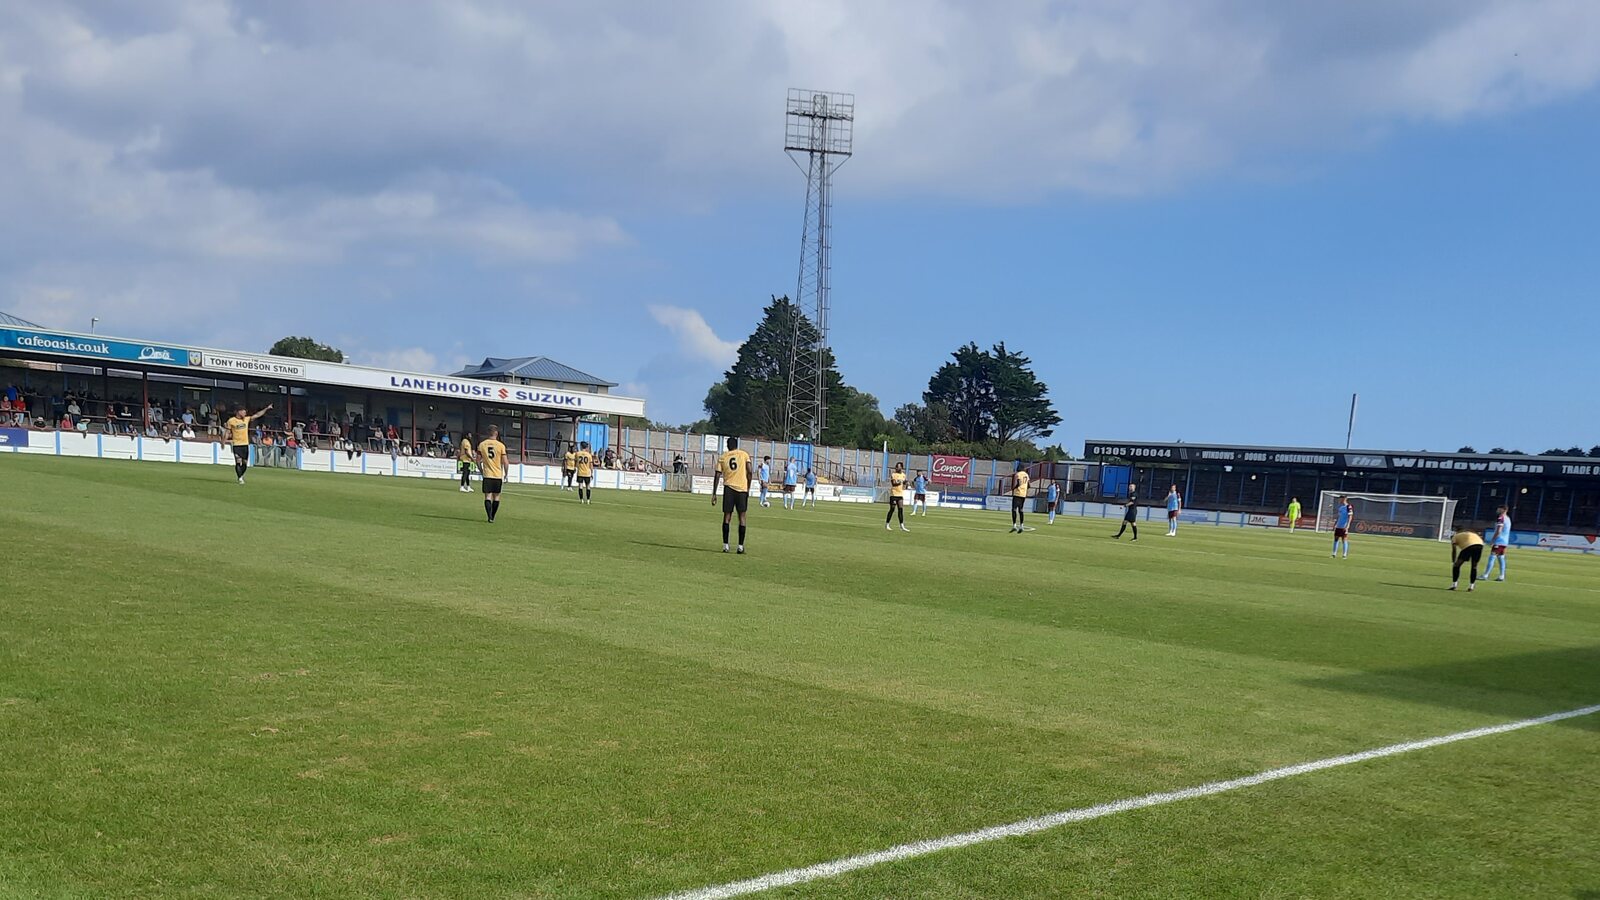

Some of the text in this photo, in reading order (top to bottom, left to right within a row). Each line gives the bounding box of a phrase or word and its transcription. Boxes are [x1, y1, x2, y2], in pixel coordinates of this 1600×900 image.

[17, 336, 109, 354] cafeoasis.co.uk
[210, 357, 299, 374] TONY HOBSON STAND
[390, 376, 582, 407] LANEHOUSE SUZUKI
[487, 446, 495, 459] 5
[1093, 446, 1171, 458] 01305 780044
[1202, 450, 1335, 465] WINDOWS DOORS CONSERVATORIES
[578, 455, 589, 465] 20
[729, 457, 738, 471] 6
[932, 457, 969, 473] Consol
[1561, 464, 1592, 475] TRADE
